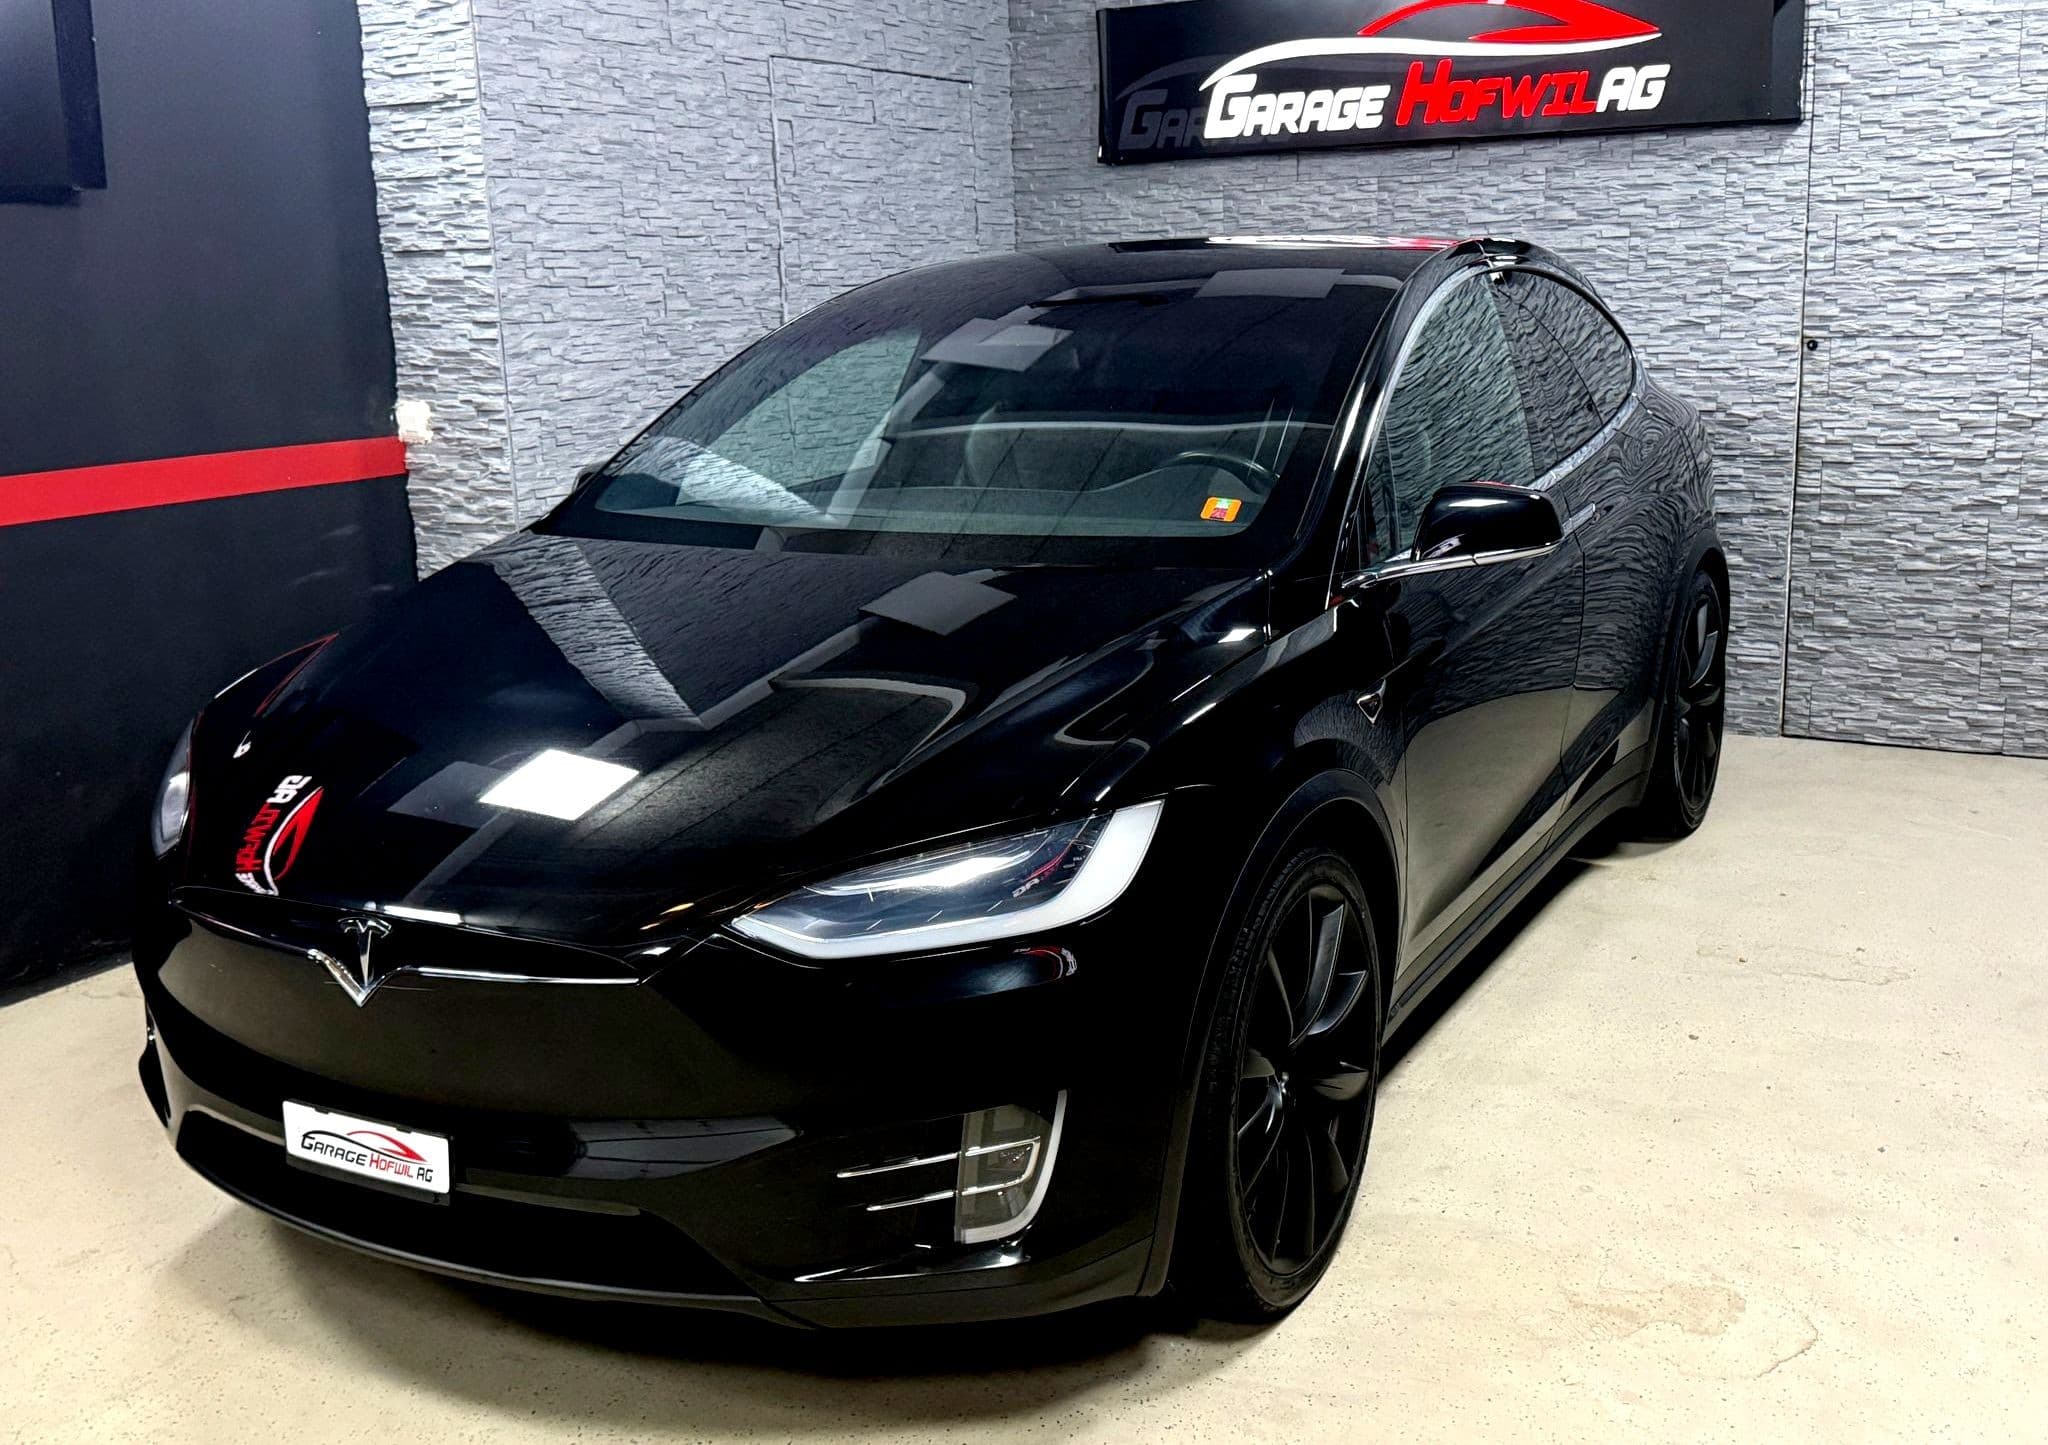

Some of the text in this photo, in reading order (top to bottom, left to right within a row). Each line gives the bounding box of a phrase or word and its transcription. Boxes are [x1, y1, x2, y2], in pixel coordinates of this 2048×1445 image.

[1204, 58, 1671, 139] GARAGE HOFWIL AG
[302, 1135, 433, 1182] GARAGE HOFWIL AG
